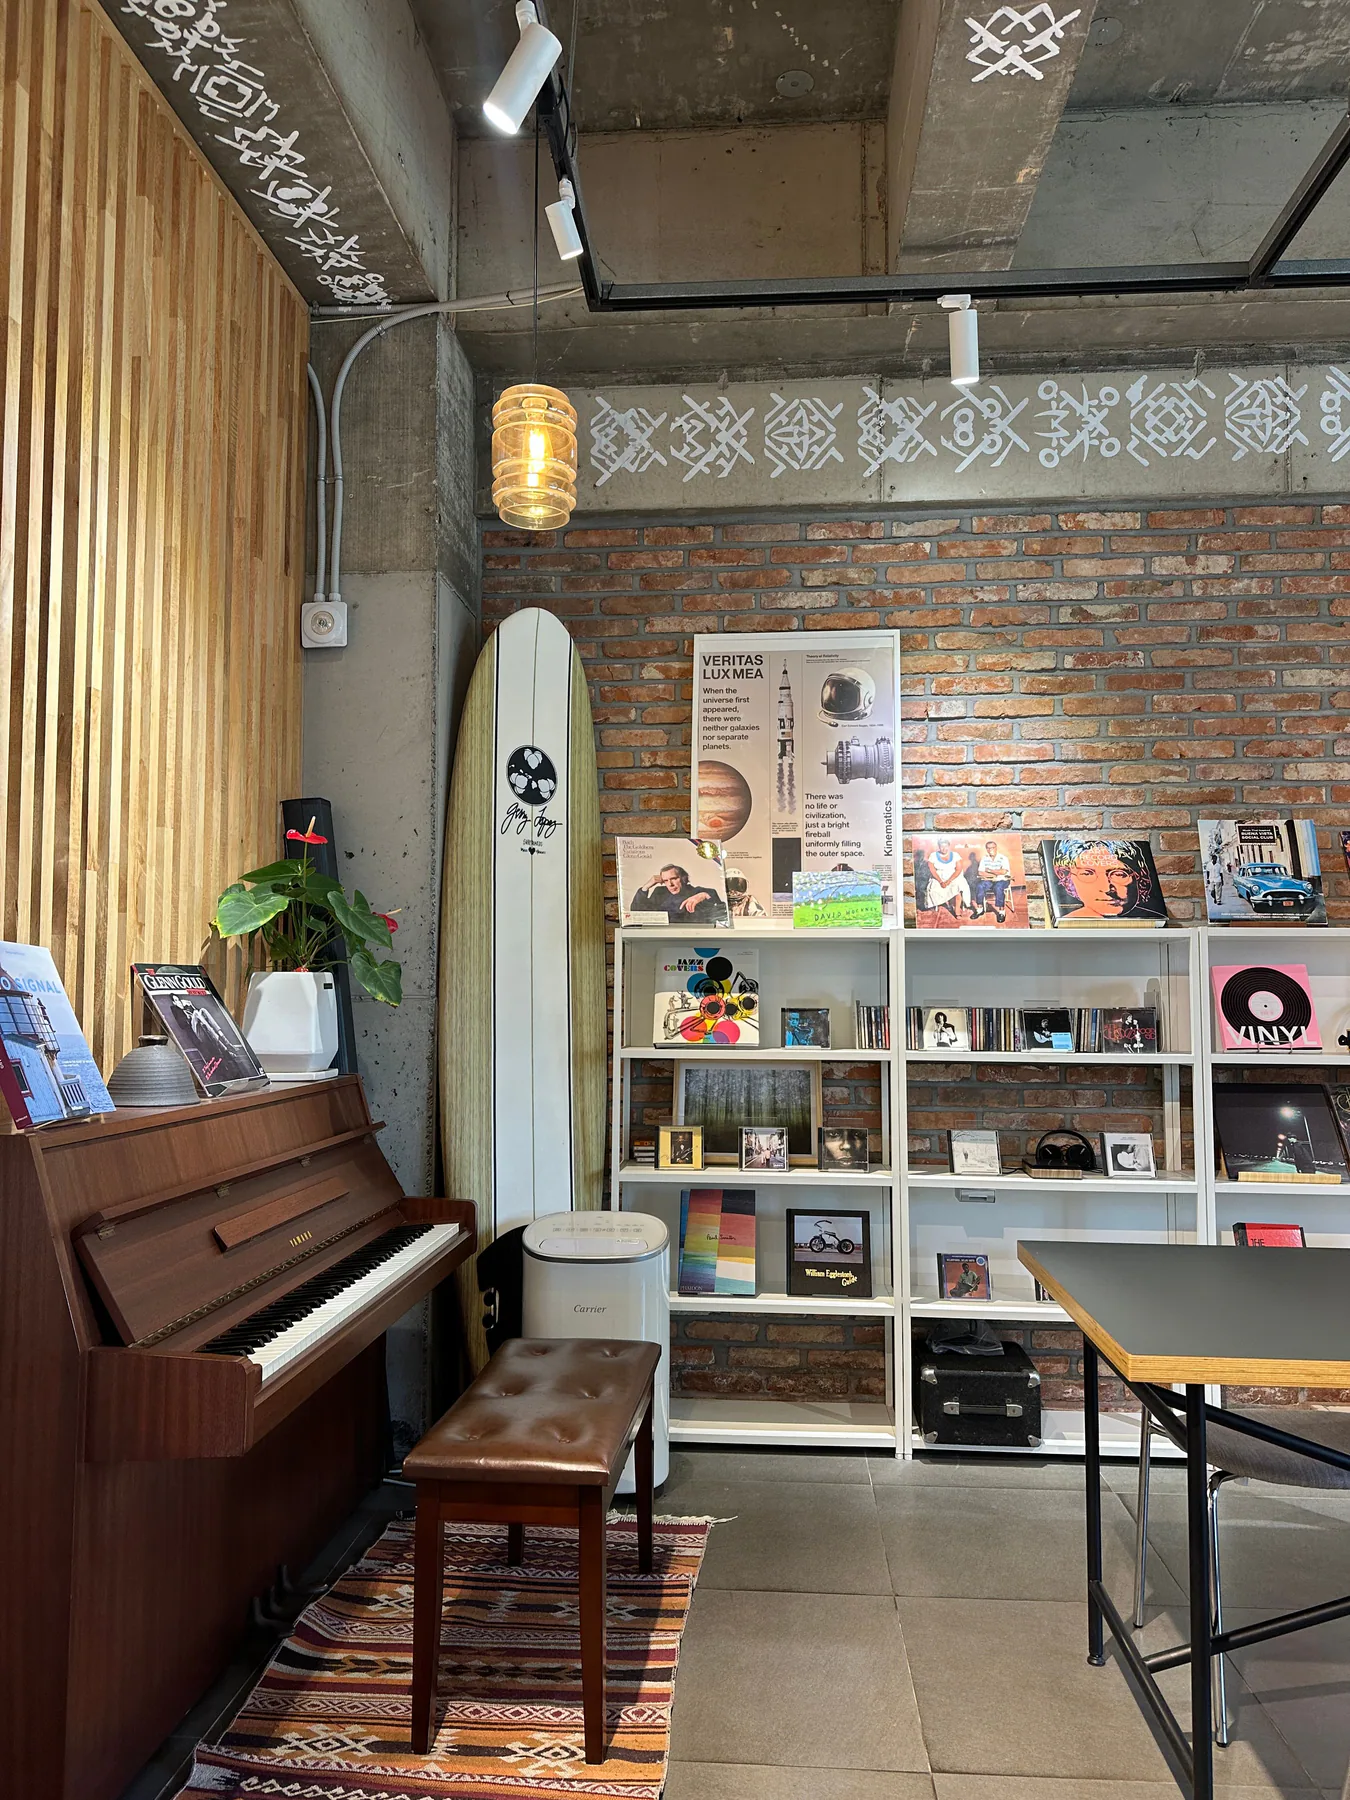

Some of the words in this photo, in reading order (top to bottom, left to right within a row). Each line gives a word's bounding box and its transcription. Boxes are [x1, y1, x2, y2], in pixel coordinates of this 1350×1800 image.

[702, 654, 764, 666] VERITAS
[703, 668, 730, 680] LUX
[732, 668, 764, 680] MEA
[702, 706, 740, 714] appeared,
[729, 724, 760, 732] galaxies
[702, 743, 732, 751] planets.
[827, 821, 850, 829] bright
[884, 800, 893, 857] Kinematics
[841, 840, 861, 848] filling
[814, 911, 842, 922] DAVID
[14, 977, 62, 994] SIGNAL
[1226, 1025, 1318, 1046] VINYL
[805, 1268, 825, 1277] William
[573, 1304, 607, 1313] Carrier
